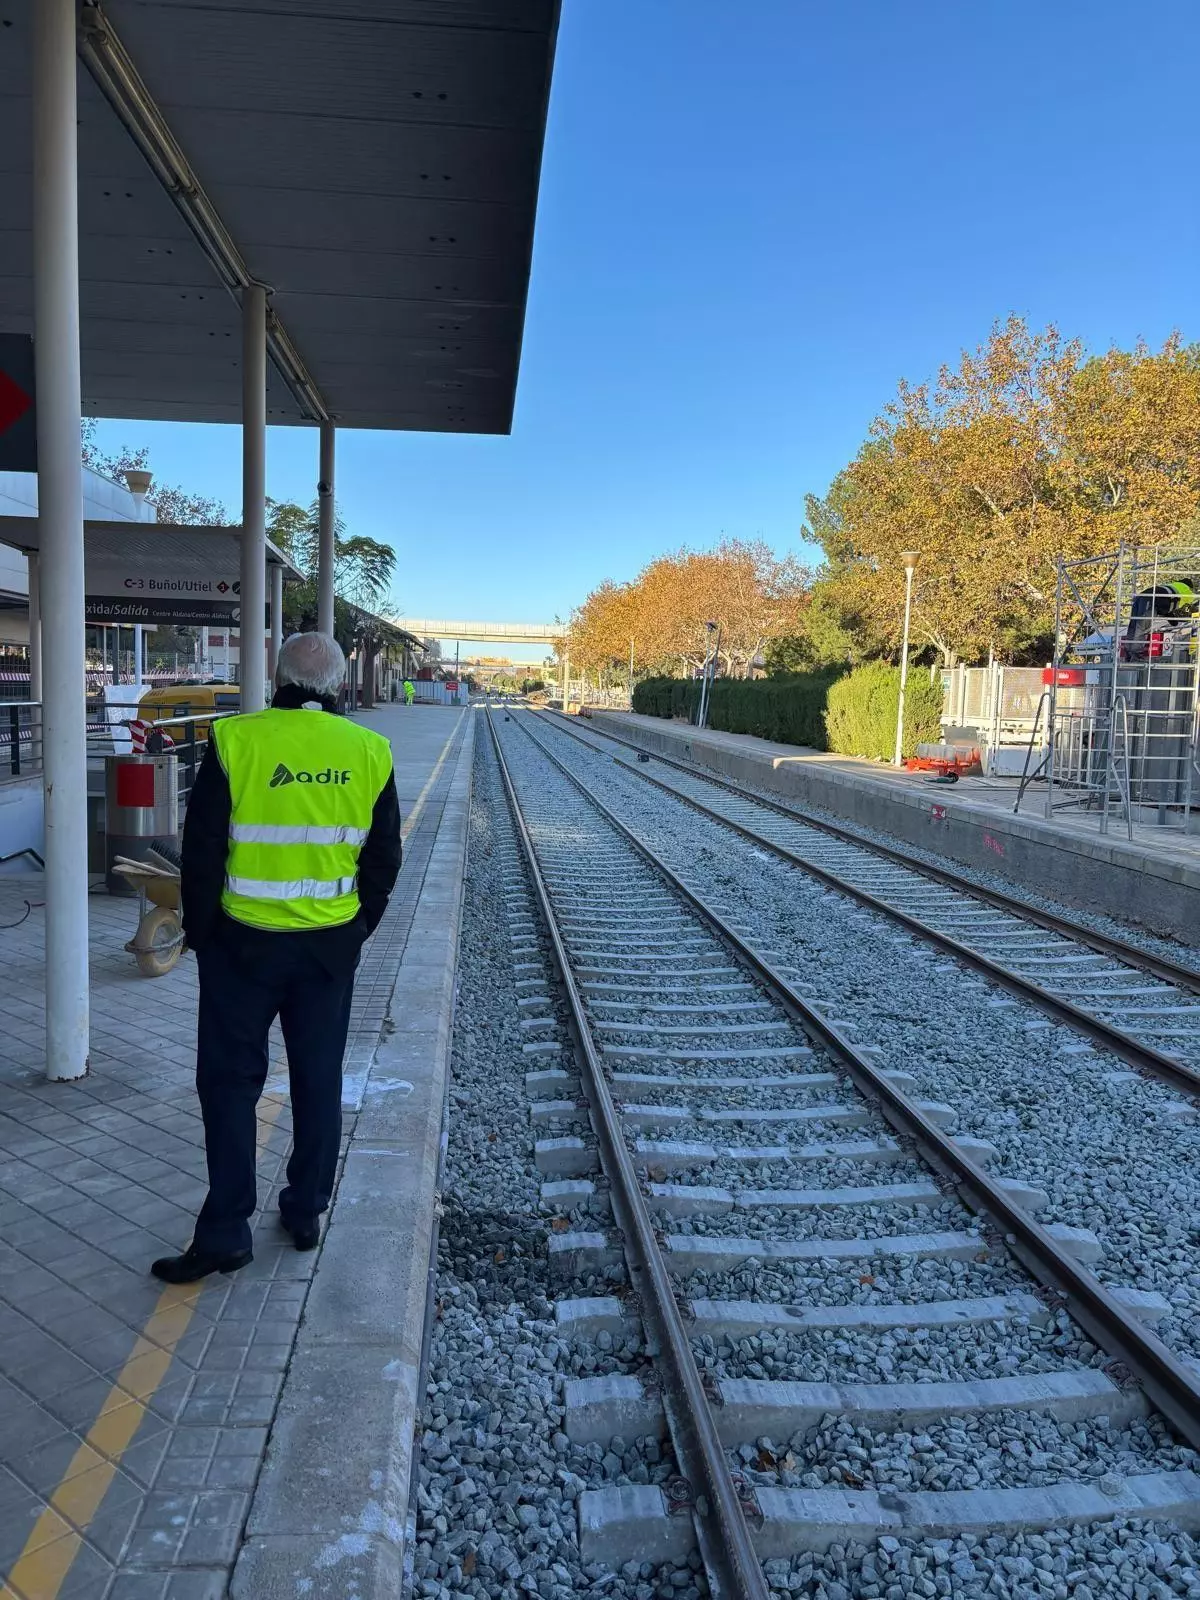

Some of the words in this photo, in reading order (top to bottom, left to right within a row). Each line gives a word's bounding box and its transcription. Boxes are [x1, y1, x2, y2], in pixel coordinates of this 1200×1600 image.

[124, 578, 145, 589] C-3
[149, 579, 212, 592] Buñol/Utiel
[86, 603, 149, 616] xida/Salida
[295, 768, 351, 785] adif
